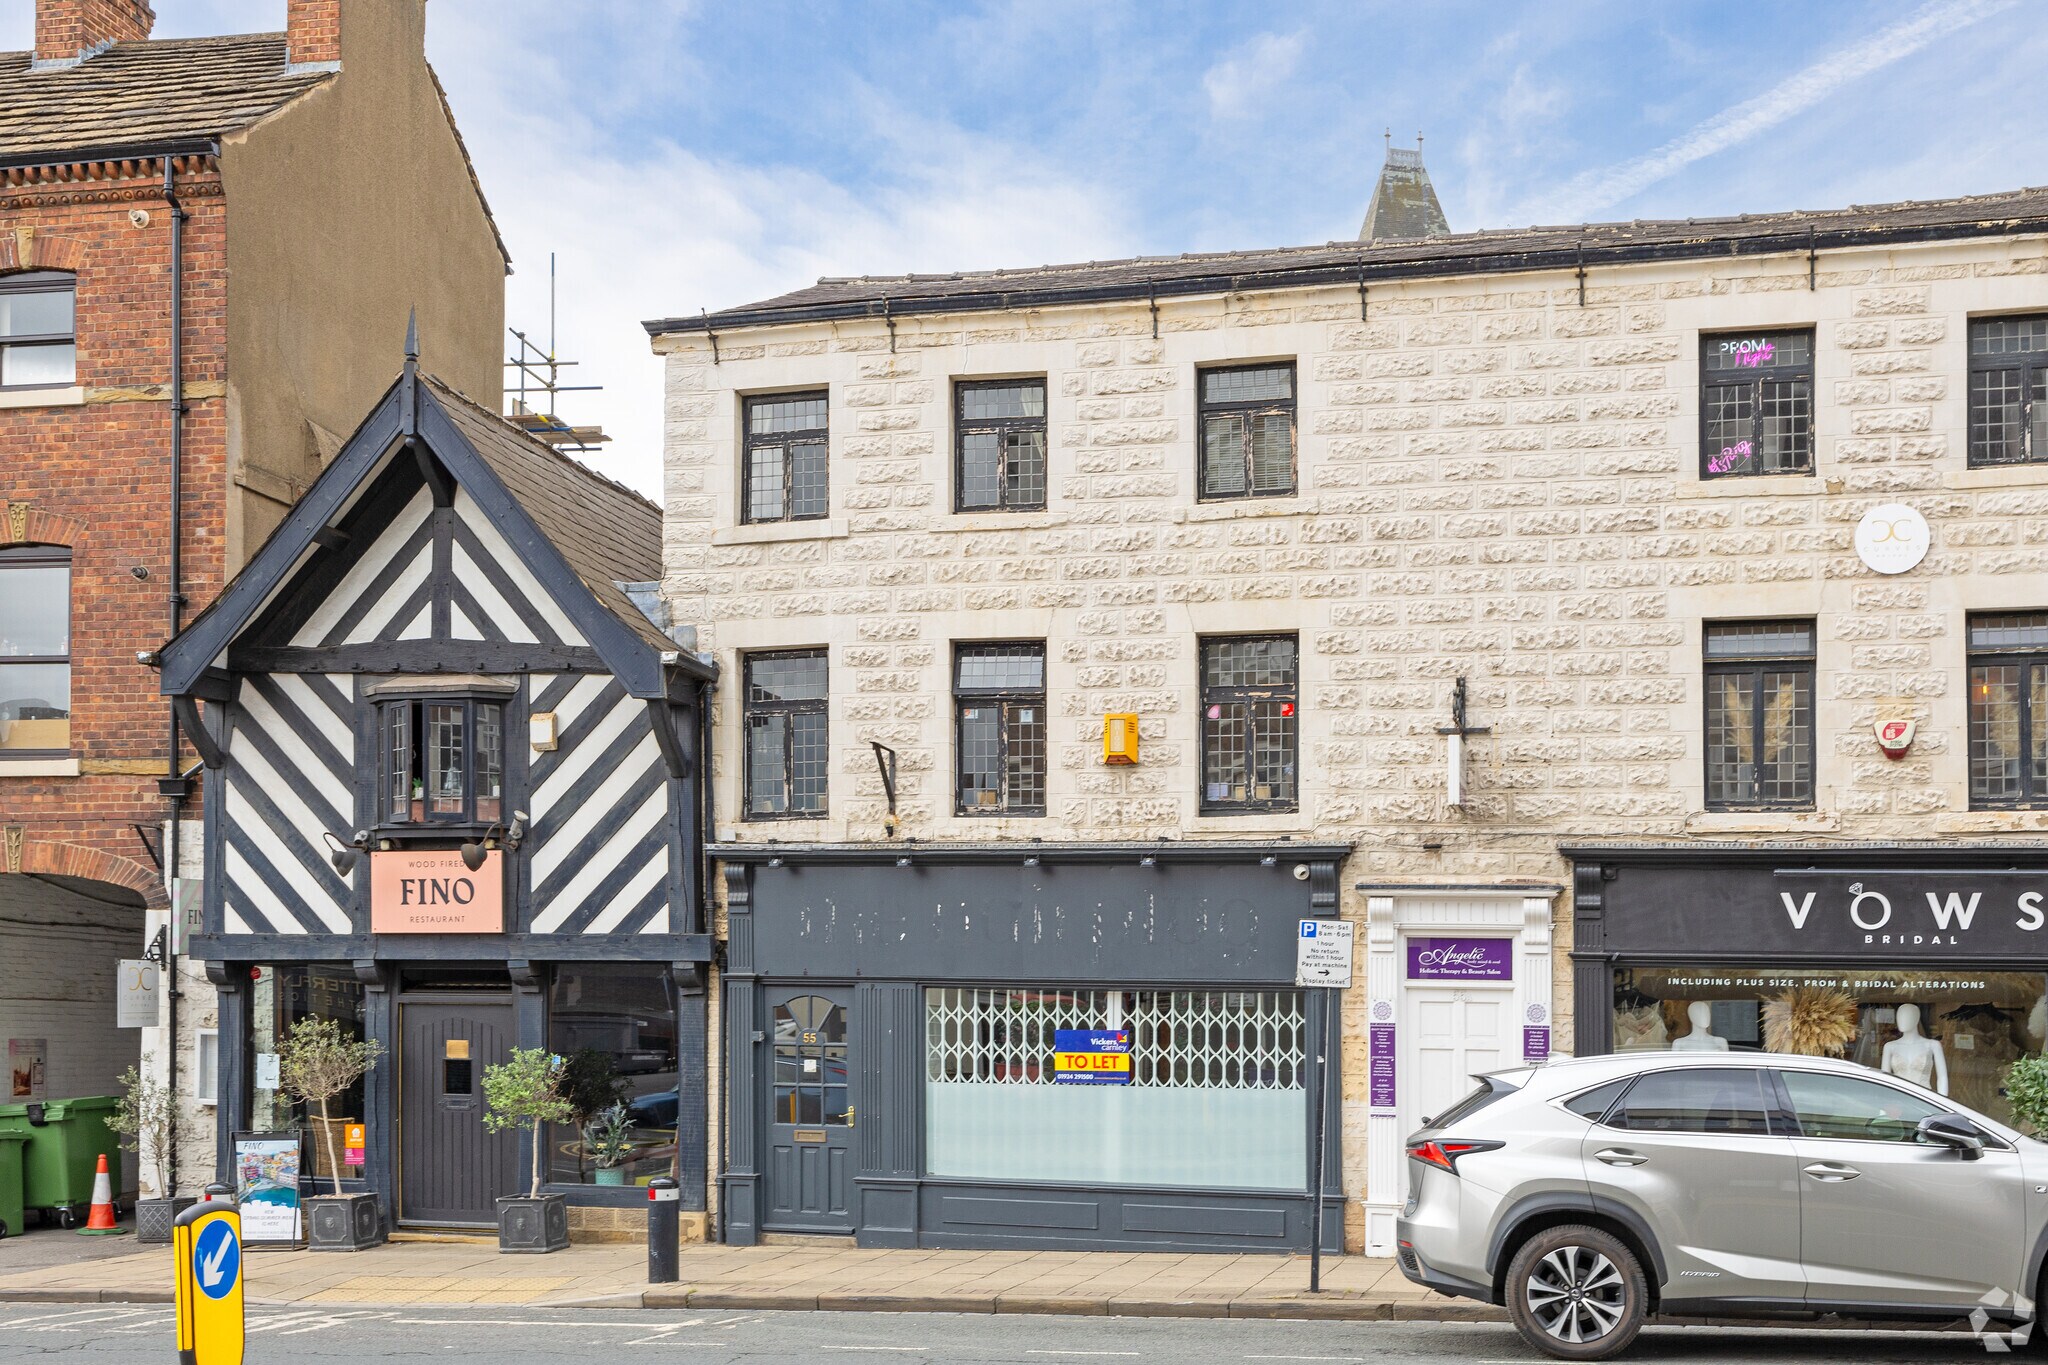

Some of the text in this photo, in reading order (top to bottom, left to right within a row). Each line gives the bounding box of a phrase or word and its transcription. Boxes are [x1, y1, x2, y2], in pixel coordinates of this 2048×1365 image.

[400, 878, 474, 905] FINO
[1780, 891, 2044, 930] VOWS
[1865, 935, 1958, 944] BRIDAL
[1418, 944, 1485, 966] Angelic
[1667, 978, 1731, 986] INCLUDING
[1769, 979, 1799, 988] SIZE,
[1804, 979, 1837, 988] PROM
[1842, 980, 1849, 988] &
[1855, 980, 1896, 988] BRIDAL
[1902, 980, 1986, 989] ALTERATIONS
[803, 1032, 816, 1043] 55
[1065, 1055, 1119, 1068] TO LET
[244, 1142, 264, 1150] FINO
